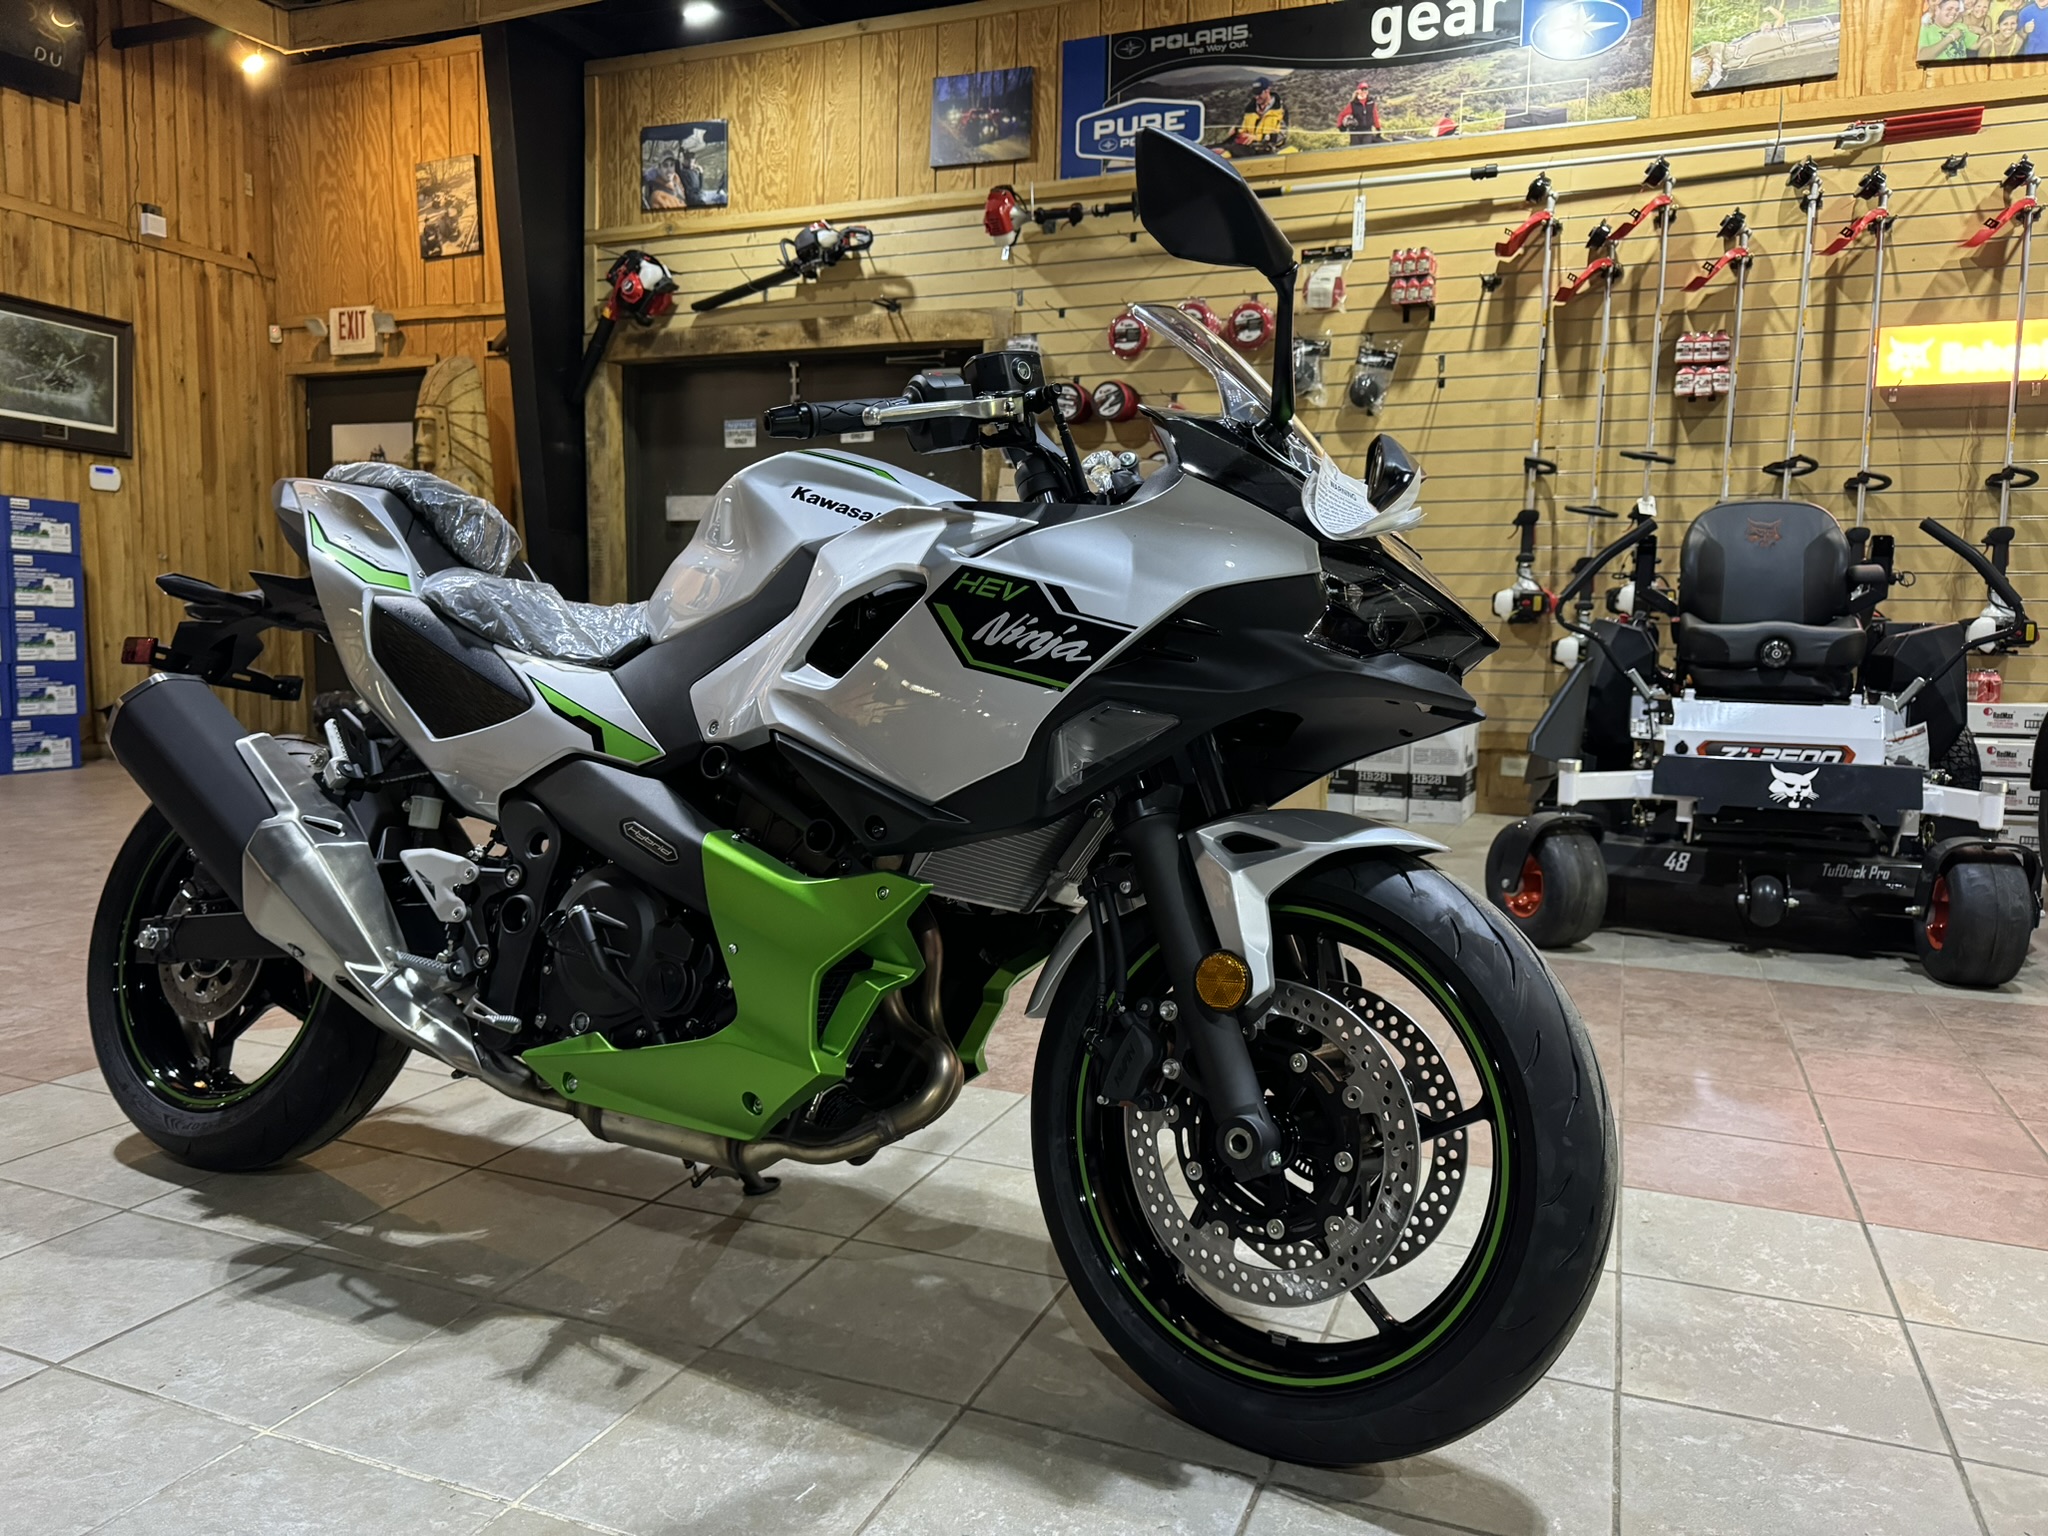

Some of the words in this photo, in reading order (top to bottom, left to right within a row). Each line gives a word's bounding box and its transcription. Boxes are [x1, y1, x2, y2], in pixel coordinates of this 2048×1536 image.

[1150, 24, 1249, 52] POLARIS
[1371, 0, 1504, 59] gear
[34, 46, 62, 68] DU
[1189, 47, 1204, 55] The
[1206, 44, 1227, 53] Way
[1229, 40, 1249, 49] Out.
[1093, 110, 1186, 140] PURE
[338, 310, 366, 340] EXIT
[791, 486, 882, 522] Kawasa
[1329, 479, 1358, 501] WARNING
[953, 572, 1031, 602] HEV
[971, 611, 1092, 664] Ninja
[1357, 772, 1392, 783] HB281
[1411, 775, 1448, 786] HB281
[627, 826, 673, 857] Hybrid
[1664, 851, 1691, 872] 48
[1822, 862, 1868, 880] TufDeck
[1868, 864, 1891, 880] Pro
